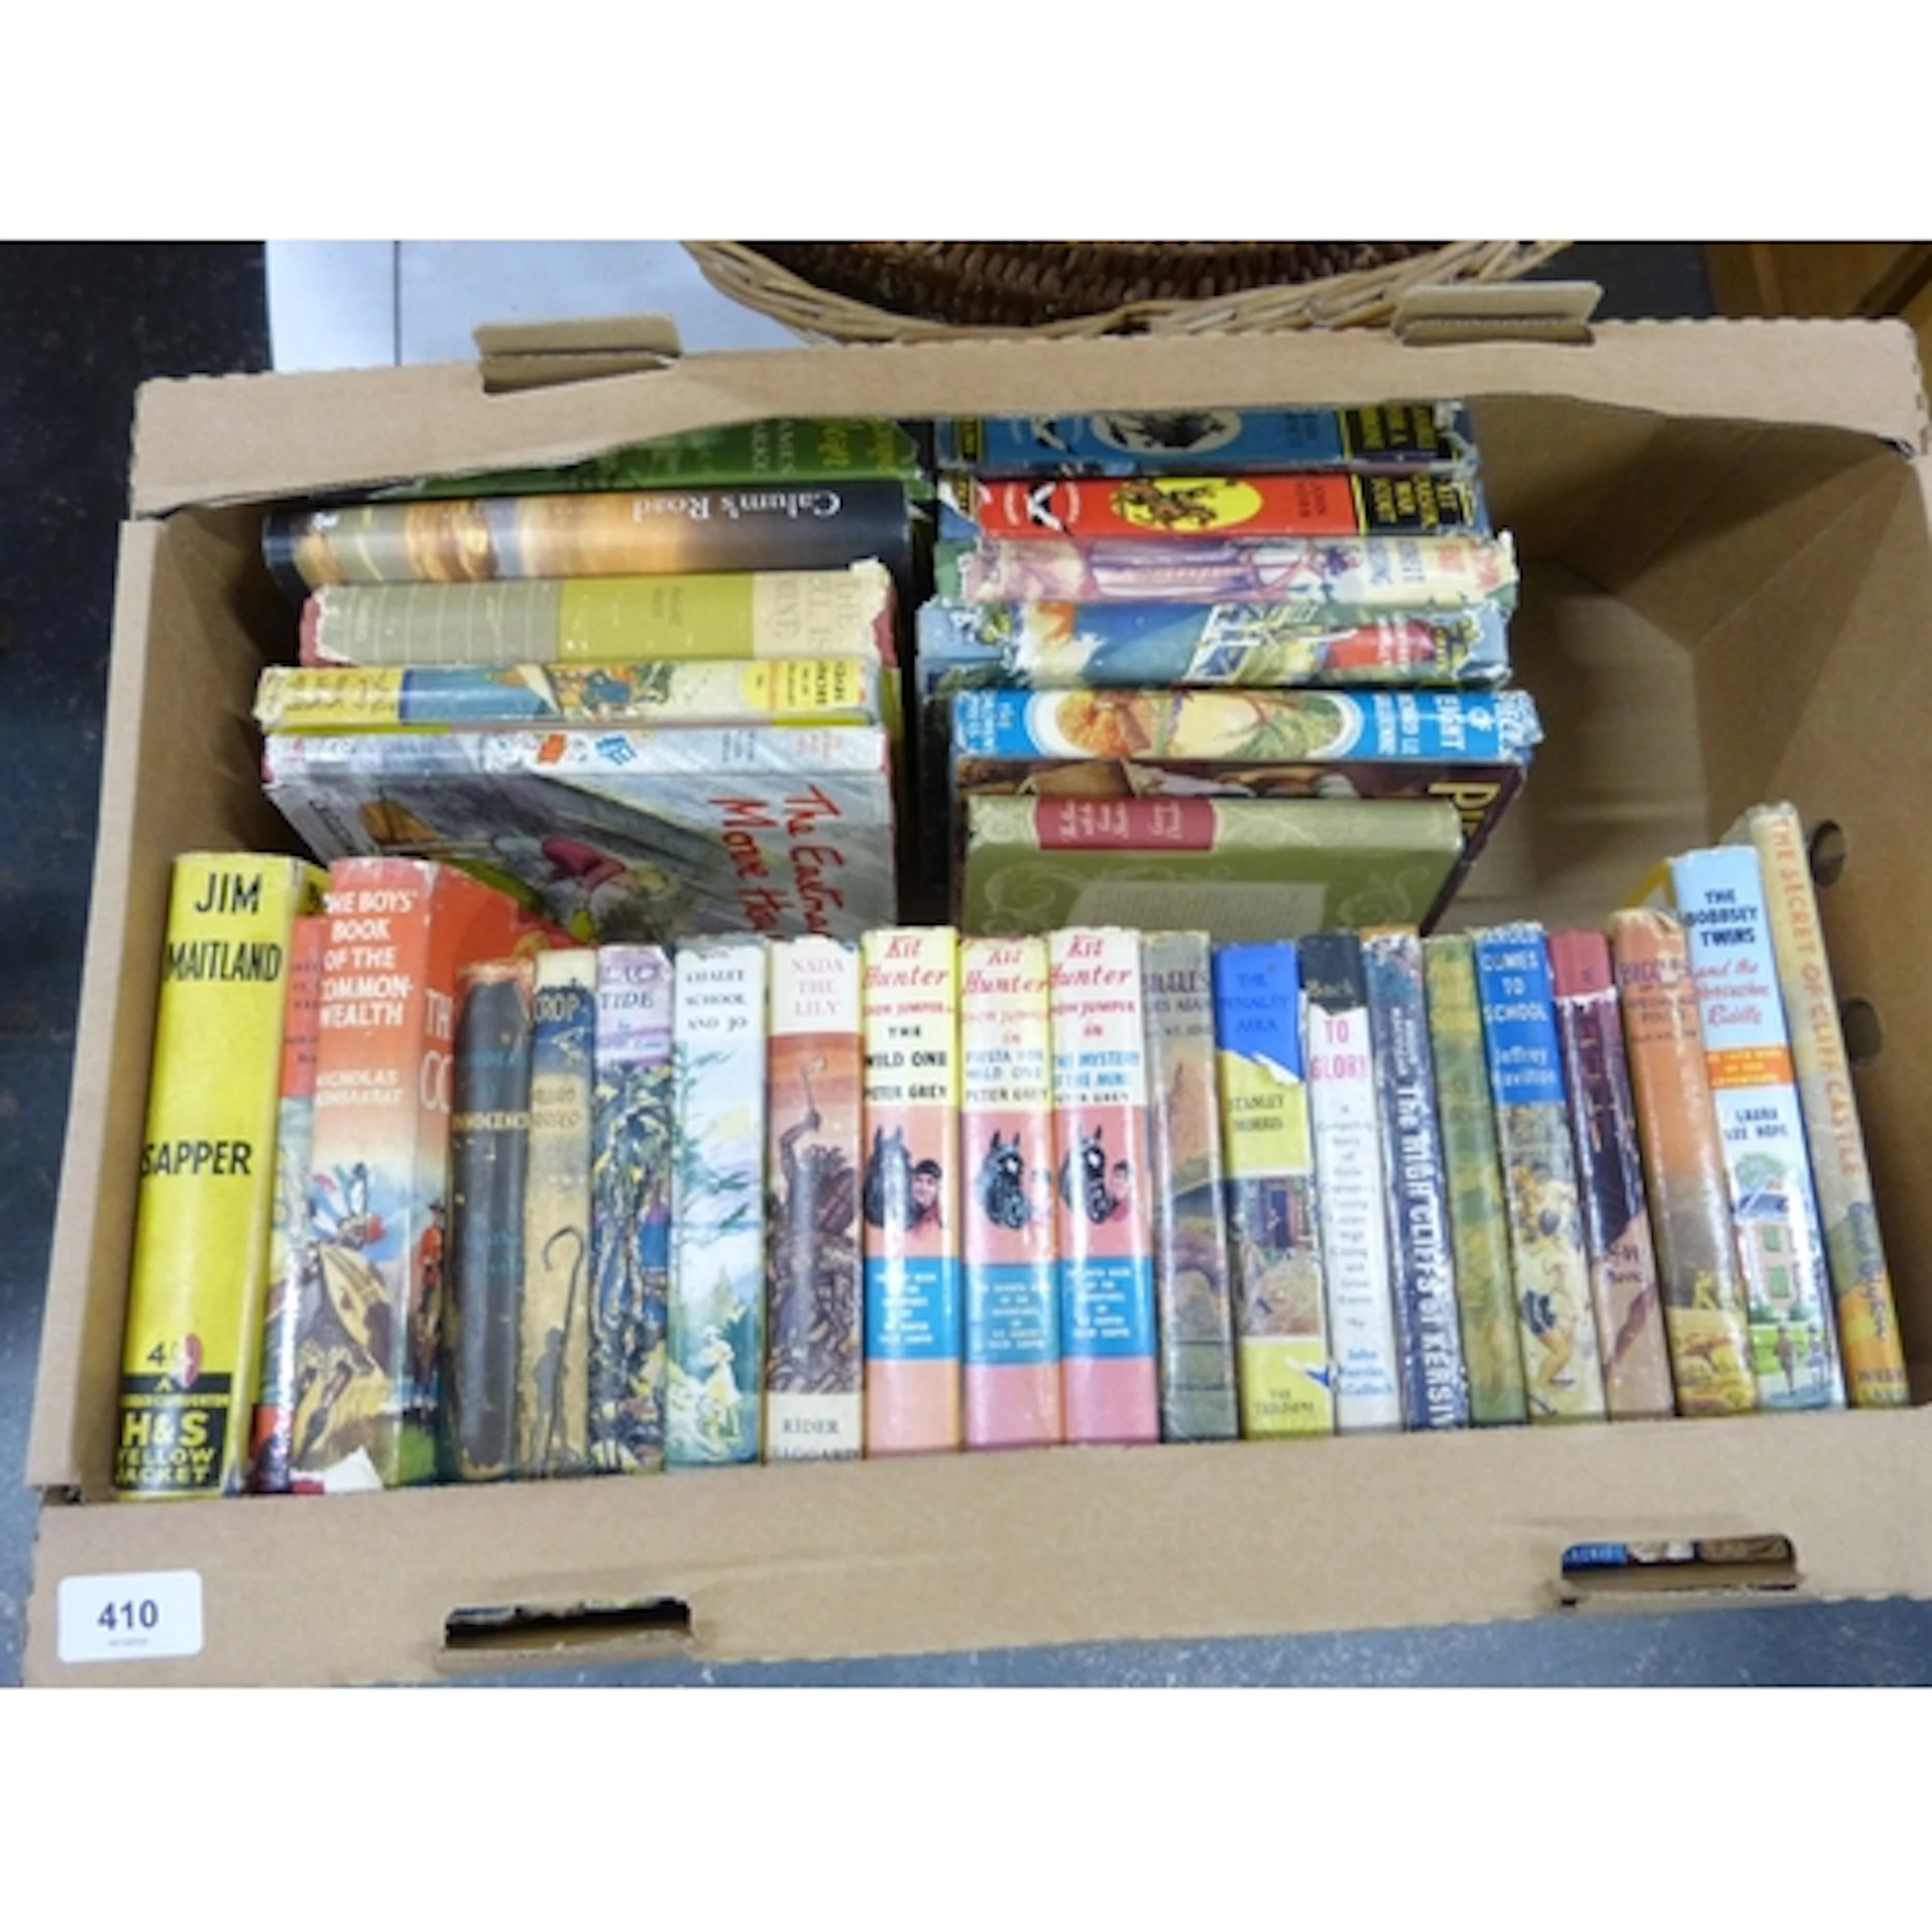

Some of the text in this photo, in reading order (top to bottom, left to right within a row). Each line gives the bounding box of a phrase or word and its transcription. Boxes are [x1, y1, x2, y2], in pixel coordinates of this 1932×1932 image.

[632, 490, 841, 523] Calum's Road
[1436, 694, 1466, 751] EIGHT
[783, 783, 843, 837] The
[194, 872, 263, 915] JIM
[1704, 889, 1736, 905] THE
[1685, 907, 1758, 927] BOBBSEY
[331, 919, 390, 943] BOOK
[1699, 927, 1755, 947] TWINS
[884, 935, 922, 959] Kit
[1066, 934, 1105, 958] Kit
[167, 940, 283, 982] MAITLAND
[324, 946, 396, 971] OF THE
[790, 958, 846, 975] NADA
[1696, 956, 1759, 979] and the
[798, 981, 837, 996] THE
[863, 964, 950, 990] Hunter
[963, 971, 1048, 995] Hunter
[1049, 965, 1132, 989] Hunter
[1501, 976, 1526, 996] TO
[685, 993, 746, 1006] SCHOOL
[794, 1000, 840, 1018] LILY
[1771, 818, 1862, 1177] THE SECRET OF CLIFF CASTLE
[687, 1016, 748, 1032] AND JO
[1484, 1002, 1548, 1024] SCHOOL
[888, 1025, 922, 1038] THE
[1324, 1020, 1349, 1044] TO
[864, 1051, 948, 1067] WILD ONE
[1310, 1056, 1367, 1082] GLORY
[908, 1084, 948, 1099] GREY
[1396, 1081, 1430, 1130] The
[1734, 1106, 1779, 1124] LAURA
[142, 1140, 253, 1178] SAPPER
[1401, 1130, 1437, 1197] HIGH
[1410, 1197, 1450, 1293] CLIFFS
[118, 1447, 217, 1466] YELLOW
[115, 1465, 208, 1484] JACKET
[97, 1599, 159, 1631] 410
